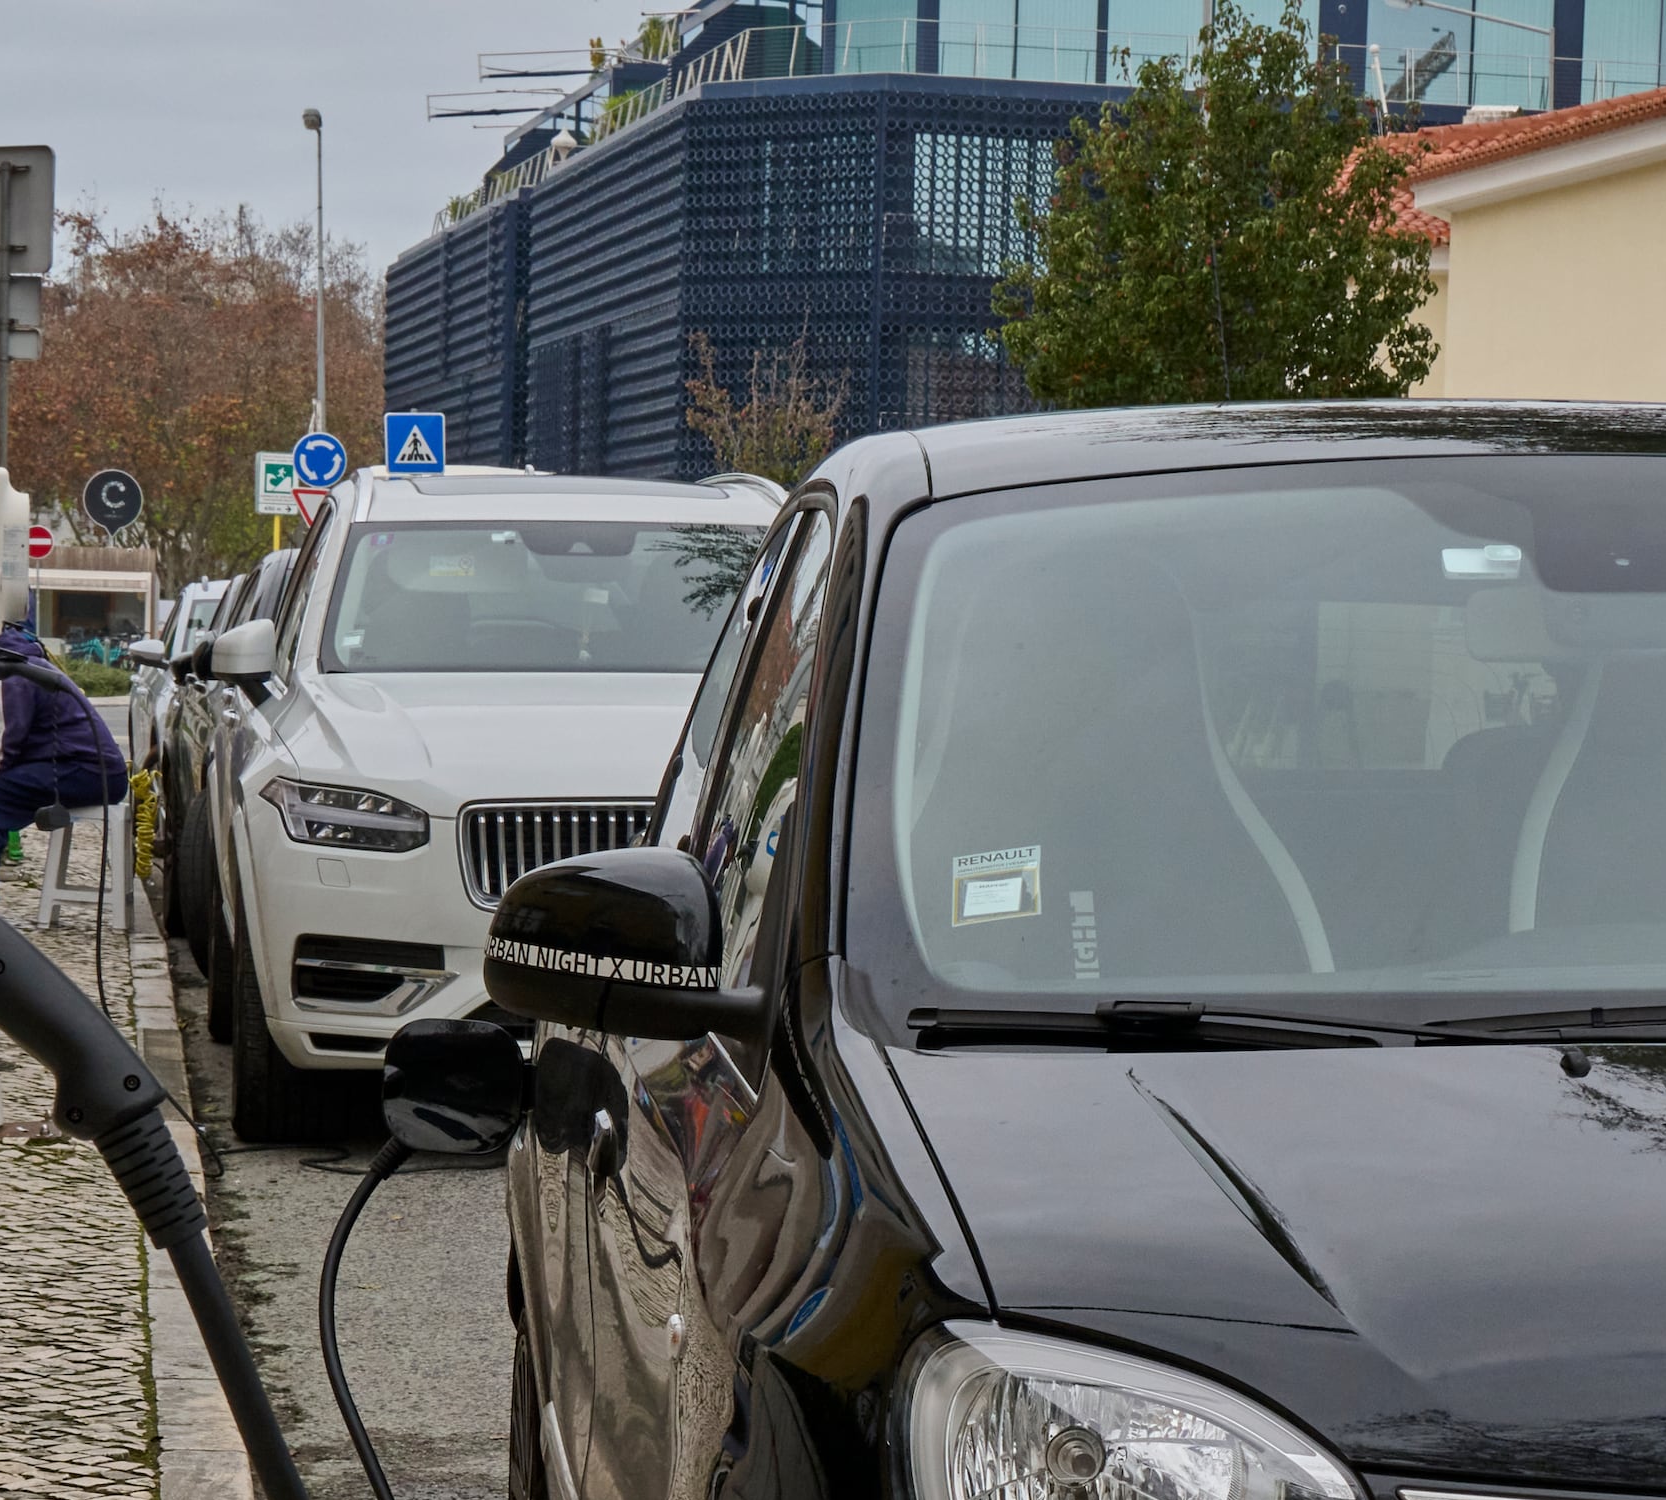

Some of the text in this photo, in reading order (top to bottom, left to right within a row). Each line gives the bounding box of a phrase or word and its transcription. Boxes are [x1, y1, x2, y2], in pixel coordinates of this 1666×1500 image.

[101, 480, 126, 509] C
[958, 847, 1037, 867] RENAULT
[538, 946, 604, 976] NIGHT
[610, 957, 625, 979] X
[633, 960, 720, 989] URBAN
